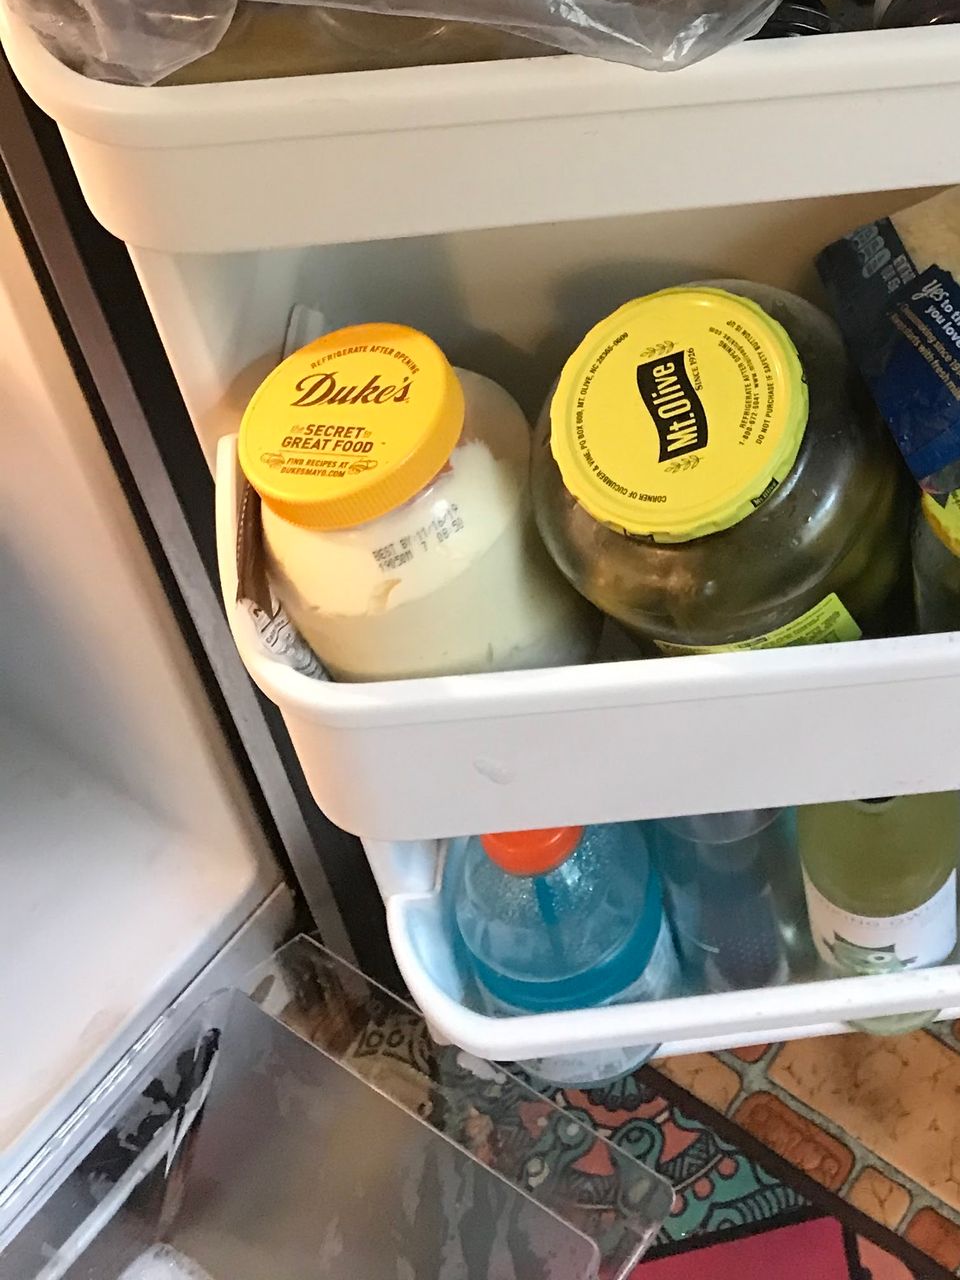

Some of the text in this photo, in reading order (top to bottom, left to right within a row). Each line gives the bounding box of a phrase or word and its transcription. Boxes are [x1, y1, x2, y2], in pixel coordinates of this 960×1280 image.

[924, 304, 946, 324] you
[940, 299, 954, 313] to
[735, 324, 742, 332] IS
[742, 331, 760, 351] BUTTON
[932, 338, 953, 362] since
[311, 345, 420, 374] REFRIGERATE AFTER OPENING
[757, 351, 771, 377] SAFETY
[916, 341, 936, 363] with
[929, 358, 951, 383] fresh
[591, 363, 600, 374] NC
[687, 347, 703, 390] SINCE 1926
[290, 371, 413, 407] Duke's
[582, 372, 595, 395] OLIVE,
[718, 340, 751, 429] REFRIGERATE AFTER OPENING
[577, 396, 585, 408] MT.
[652, 362, 698, 452] Mt.Olive
[766, 385, 774, 418] PURCHASE
[304, 424, 365, 439] SECRET
[761, 420, 770, 433] NOT
[281, 436, 374, 453] GREAT FOOD
[580, 439, 586, 450] PO
[756, 434, 765, 445] DO
[280, 467, 345, 478] DUKESMAYO.COM
[306, 459, 338, 468] RECIPES
[339, 461, 350, 469] AT
[593, 463, 599, 471] &
[597, 469, 627, 495] CUCUMBER
[628, 488, 638, 499] OF
[639, 492, 667, 503] CORNER
[372, 543, 396, 561] BEST
